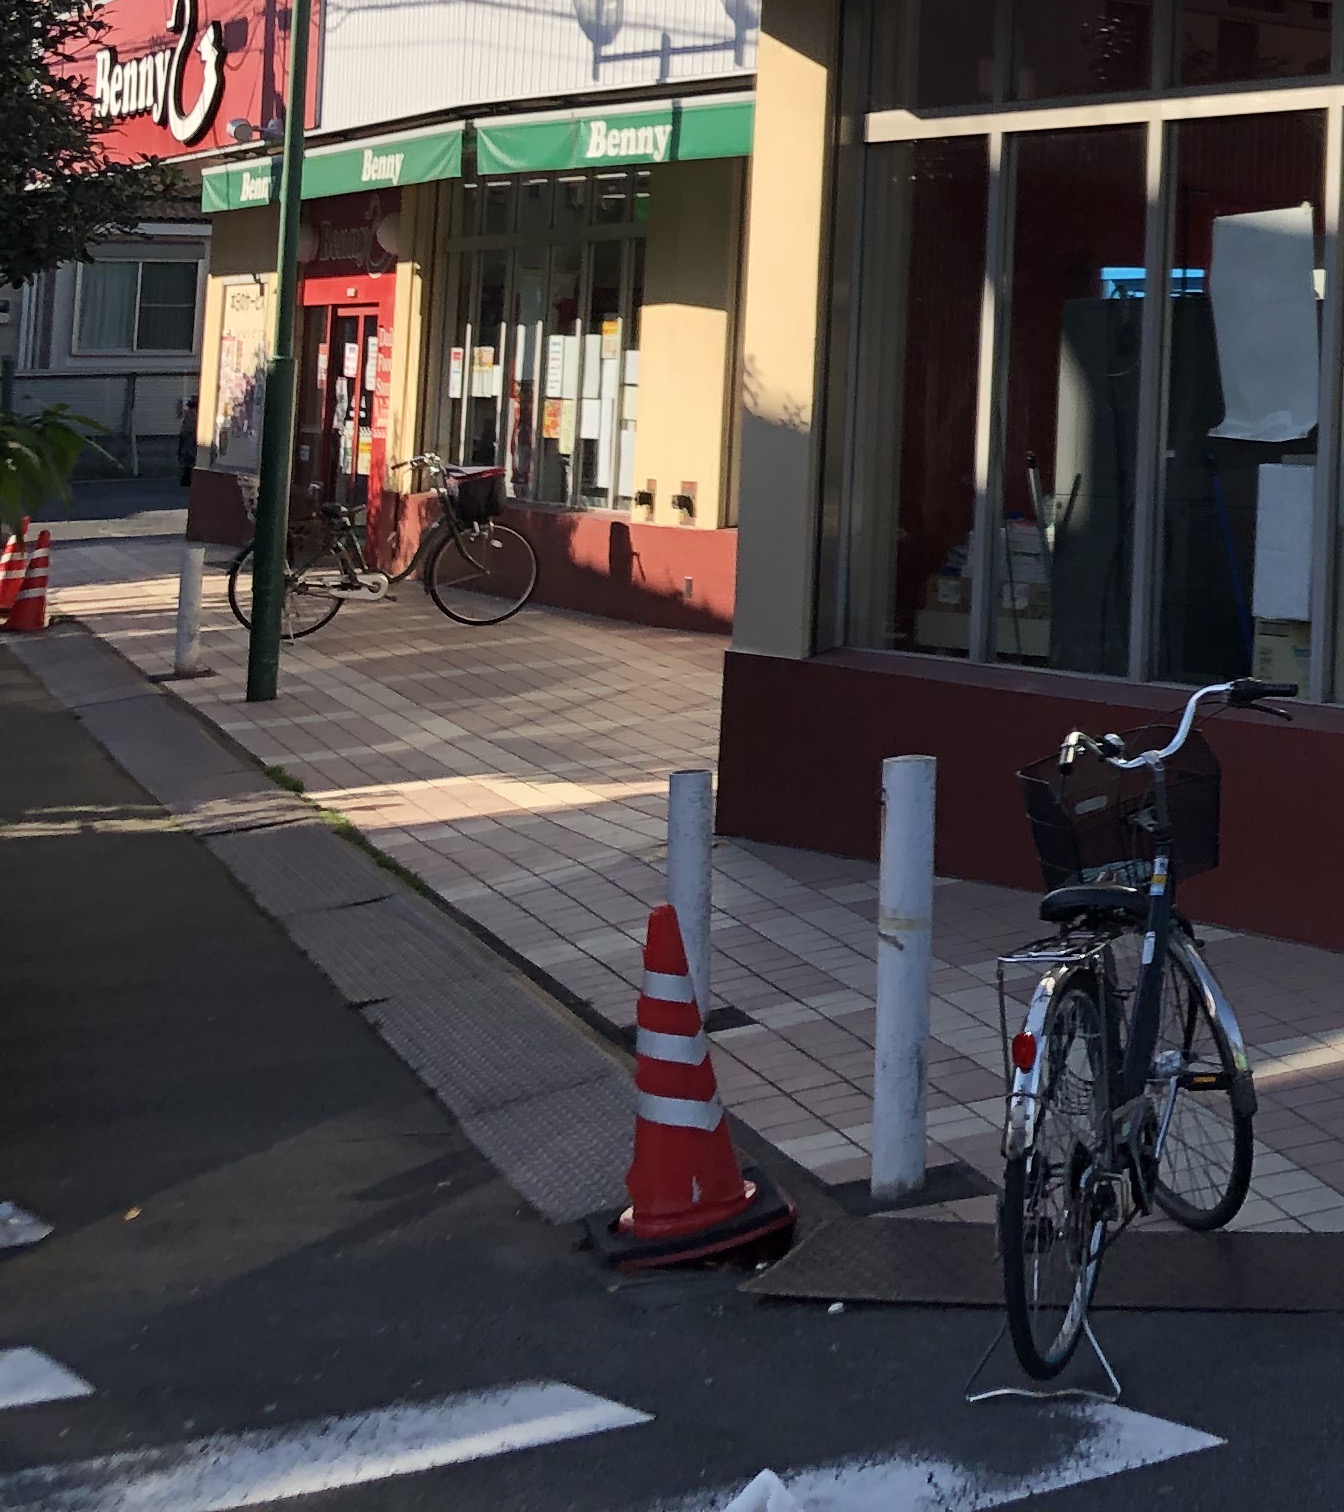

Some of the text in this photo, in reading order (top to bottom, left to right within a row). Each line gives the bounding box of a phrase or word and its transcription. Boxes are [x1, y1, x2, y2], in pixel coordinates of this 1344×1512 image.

[95, 46, 173, 126] Benny
[585, 120, 672, 161] Benny
[361, 149, 404, 185] Benny
